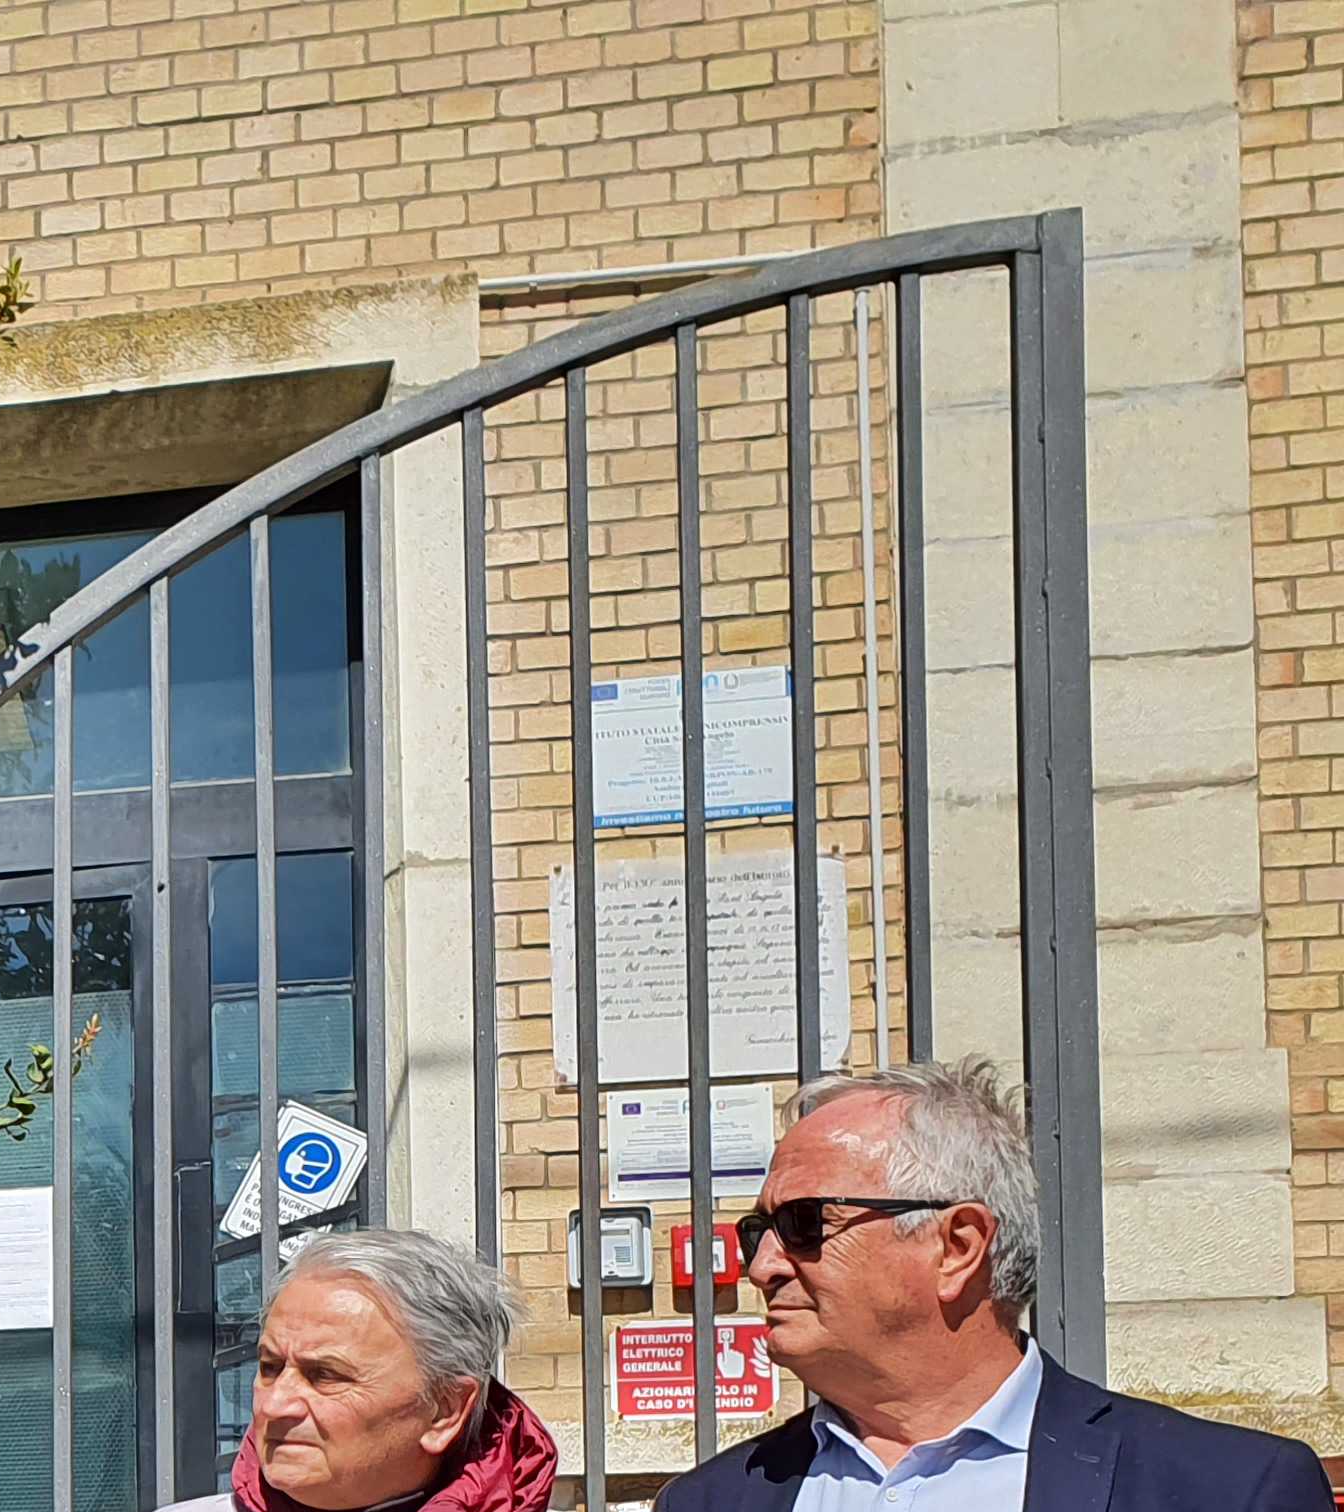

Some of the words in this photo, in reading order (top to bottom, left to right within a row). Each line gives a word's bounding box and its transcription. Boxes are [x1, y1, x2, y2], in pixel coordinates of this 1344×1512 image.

[601, 812, 672, 826] Investiamo
[742, 804, 783, 816] futuro
[622, 1333, 693, 1345] INTERRUTTO
[622, 1347, 684, 1359] ELETTRICO
[622, 1360, 682, 1373] GENERALE
[743, 1384, 758, 1396] IN
[636, 1399, 673, 1410] CASO
